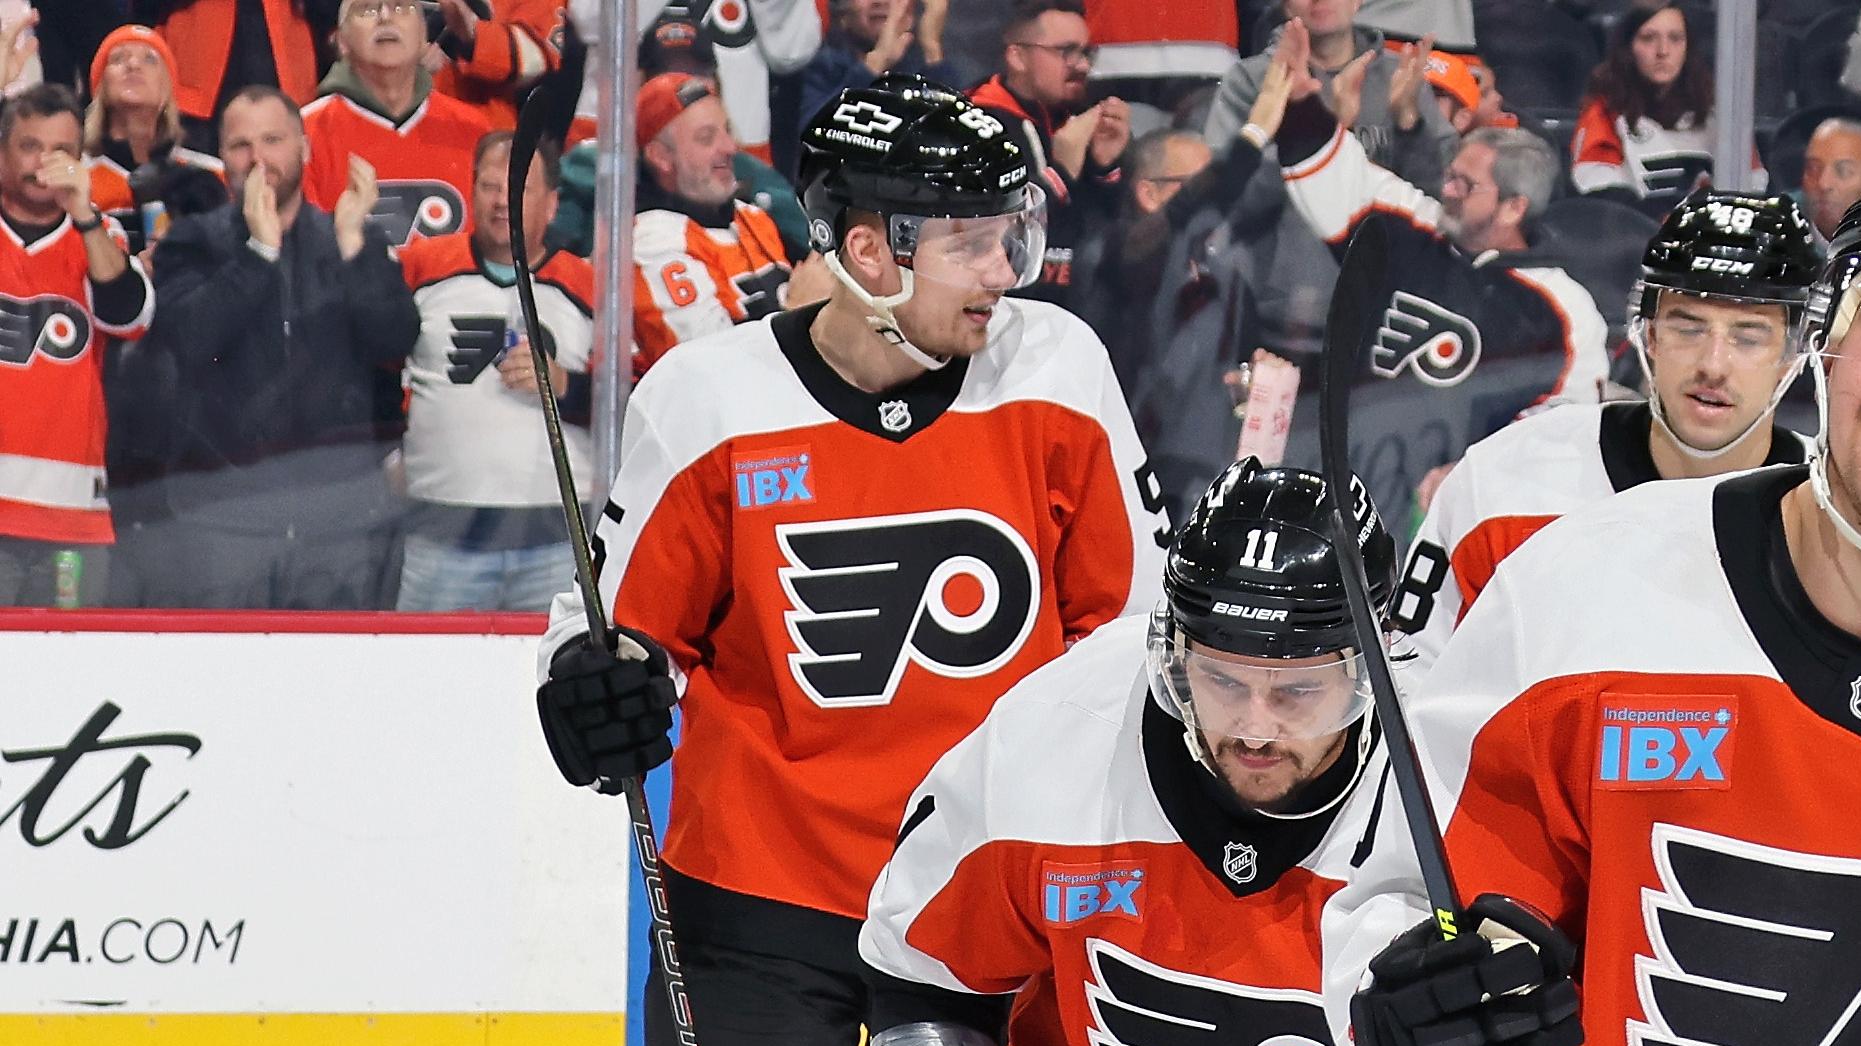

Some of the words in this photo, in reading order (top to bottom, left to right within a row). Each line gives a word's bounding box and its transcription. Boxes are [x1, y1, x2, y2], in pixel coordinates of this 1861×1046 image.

[826, 128, 892, 152] CHEVROLET
[999, 164, 1028, 188] CCM
[1708, 205, 1755, 234] 48
[1691, 256, 1755, 275] CCM
[736, 465, 812, 508] IBX
[1239, 528, 1279, 570] 11
[1212, 601, 1289, 622] BAUER
[1603, 707, 1711, 725] Independence
[1600, 726, 1729, 782] IBX
[1046, 868, 1129, 885] Independence
[1045, 880, 1142, 923] IBX
